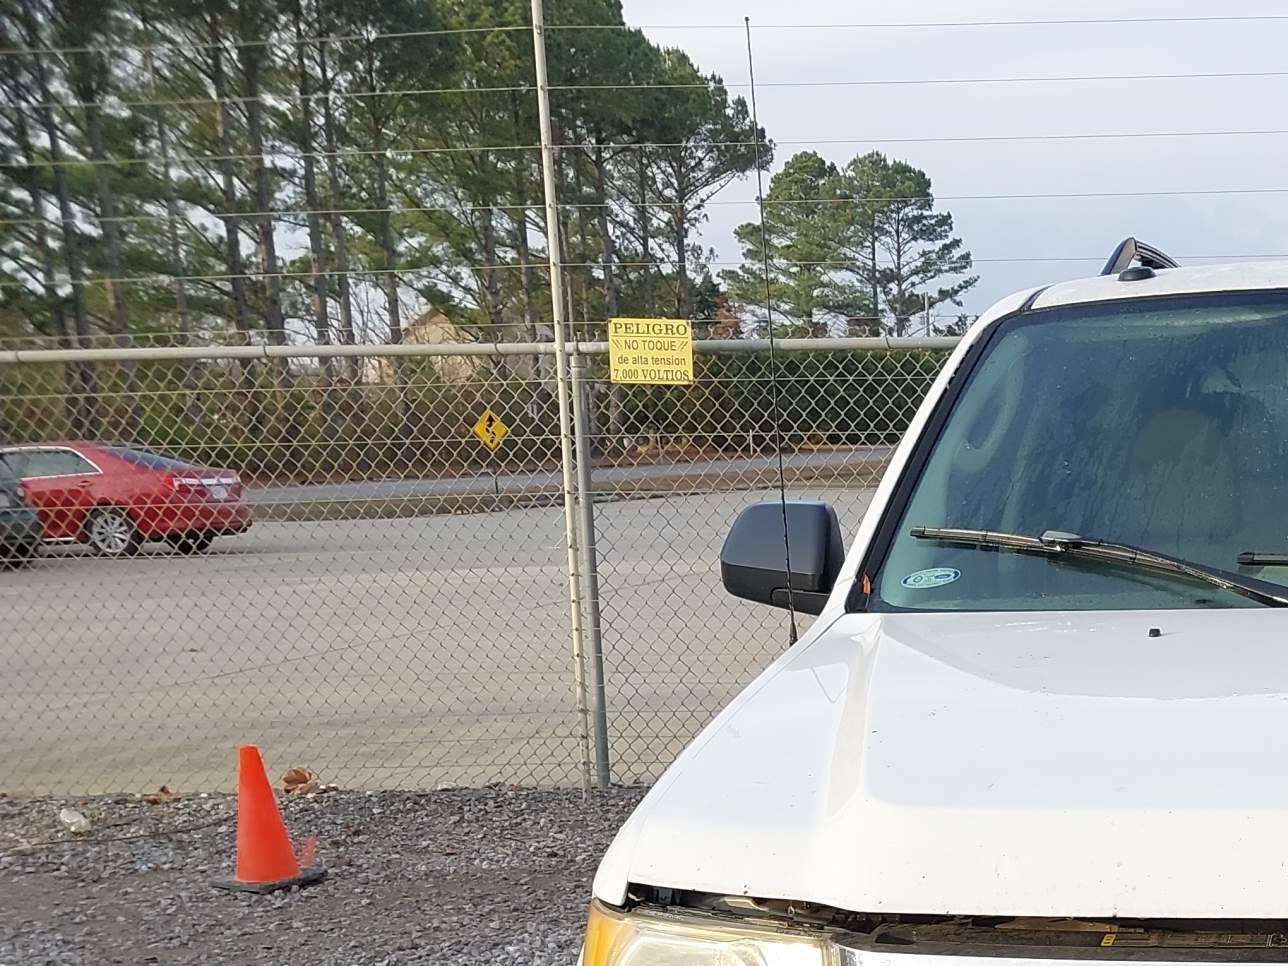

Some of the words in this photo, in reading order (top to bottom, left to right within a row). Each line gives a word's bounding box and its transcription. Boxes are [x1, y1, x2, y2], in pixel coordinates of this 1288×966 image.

[613, 322, 688, 336] PELIGRO
[624, 339, 639, 350] NO
[641, 340, 677, 351] TOQUE
[617, 354, 629, 365] de
[632, 355, 649, 365] alta
[651, 356, 686, 366] tension
[641, 369, 689, 381] VOLTIOS
